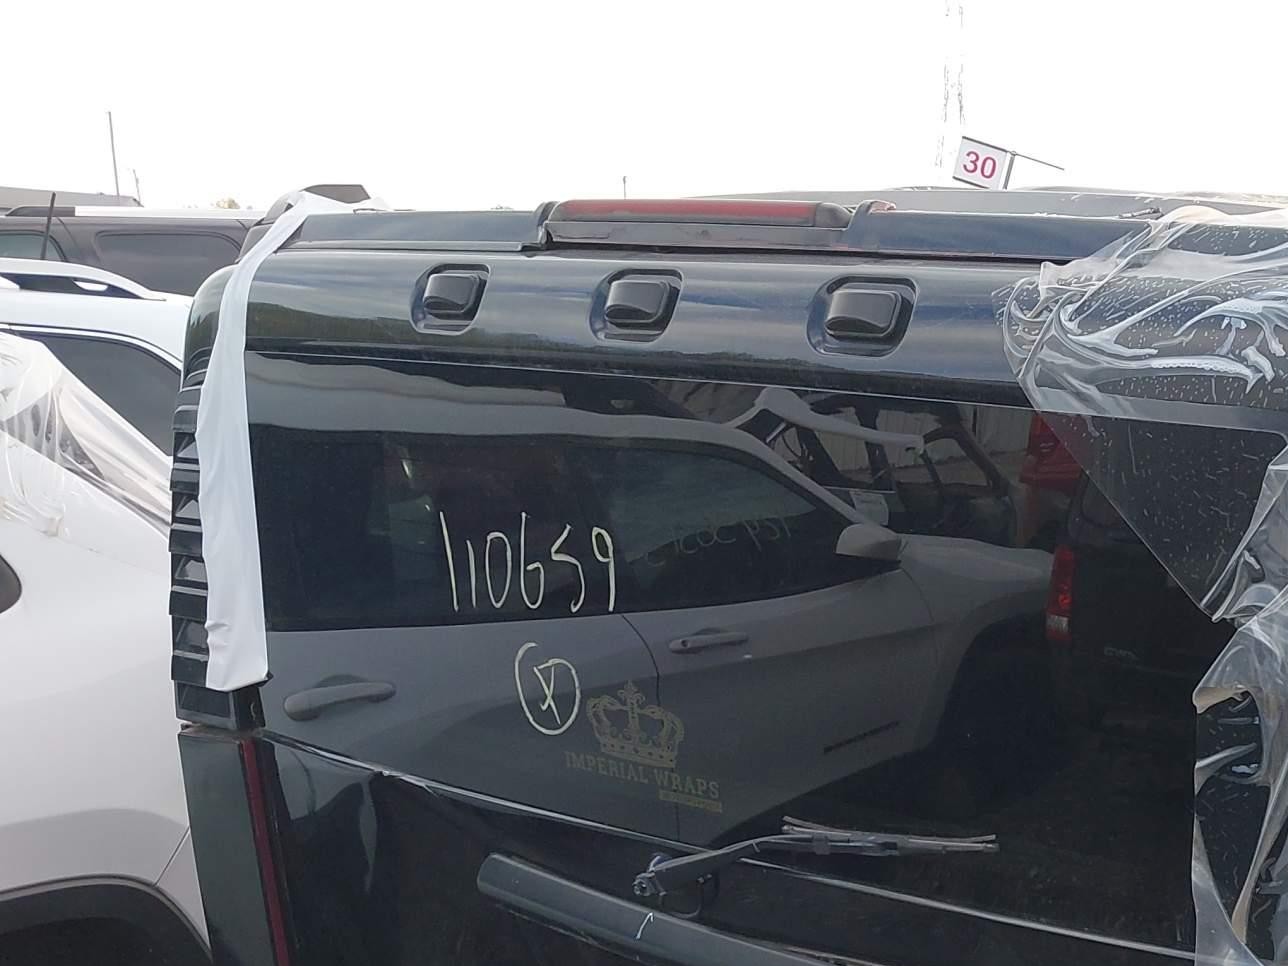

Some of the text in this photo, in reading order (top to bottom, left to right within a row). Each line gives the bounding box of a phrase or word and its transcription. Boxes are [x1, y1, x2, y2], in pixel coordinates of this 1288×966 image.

[962, 150, 997, 180] 30
[439, 511, 616, 613] 110659
[564, 750, 720, 799] IMPERIAL WRAPS
